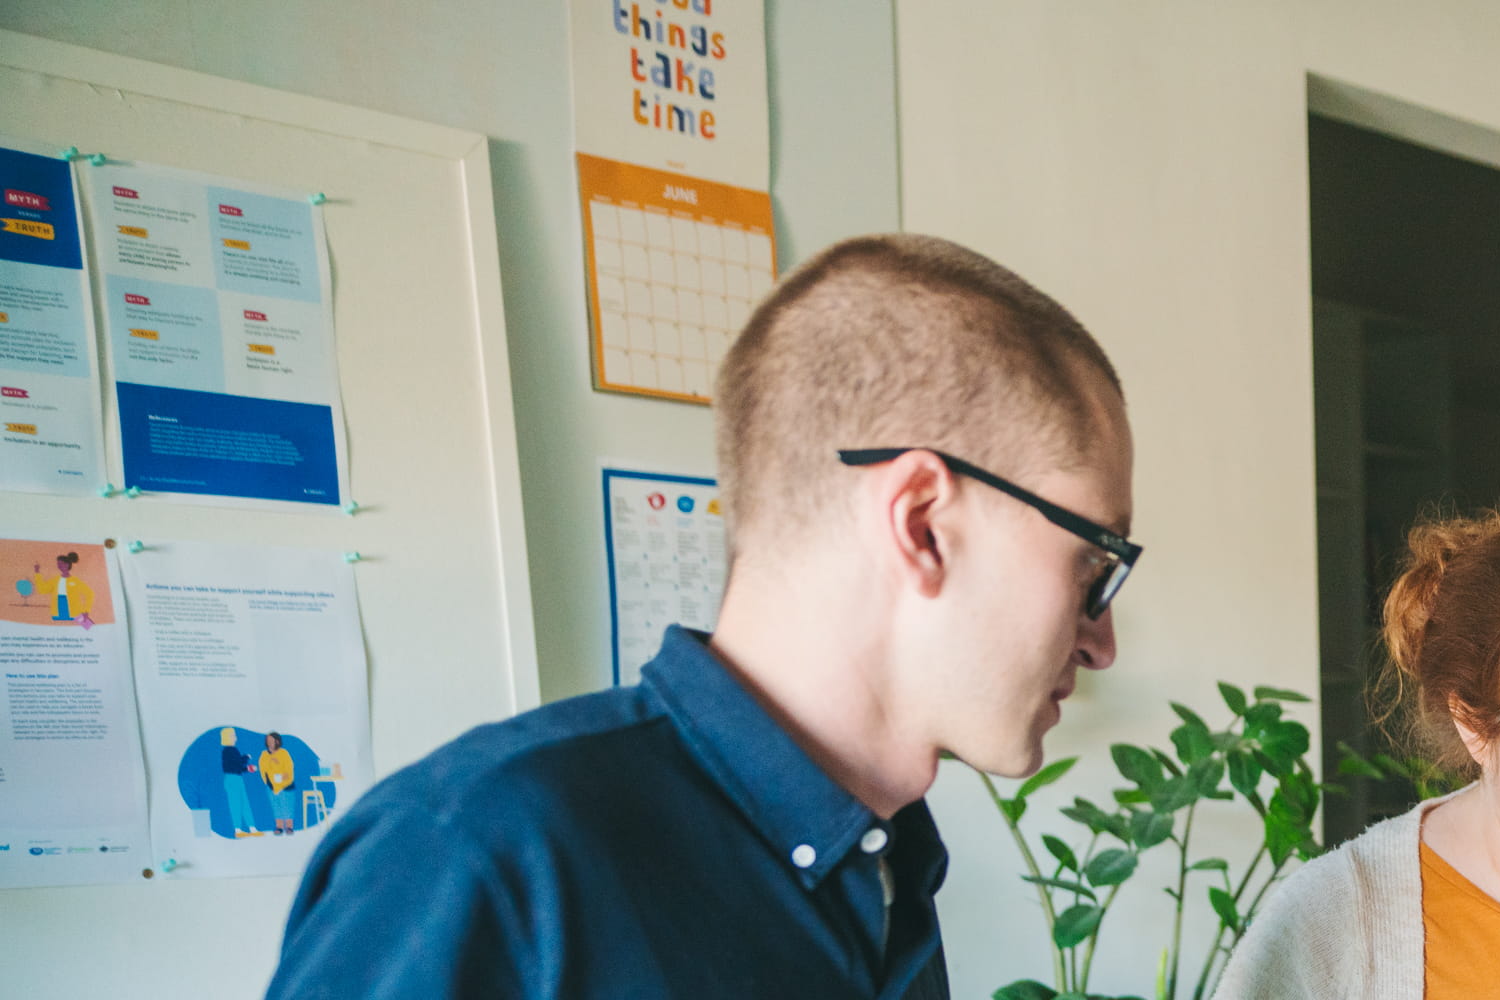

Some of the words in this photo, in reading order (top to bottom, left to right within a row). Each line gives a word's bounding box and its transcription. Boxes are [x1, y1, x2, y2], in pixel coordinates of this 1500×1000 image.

[613, 0, 726, 59] things
[630, 47, 715, 100] take
[633, 88, 716, 139] time
[9, 193, 40, 206] MYTH
[663, 183, 698, 205] JUNE
[14, 222, 50, 235] TRUTH
